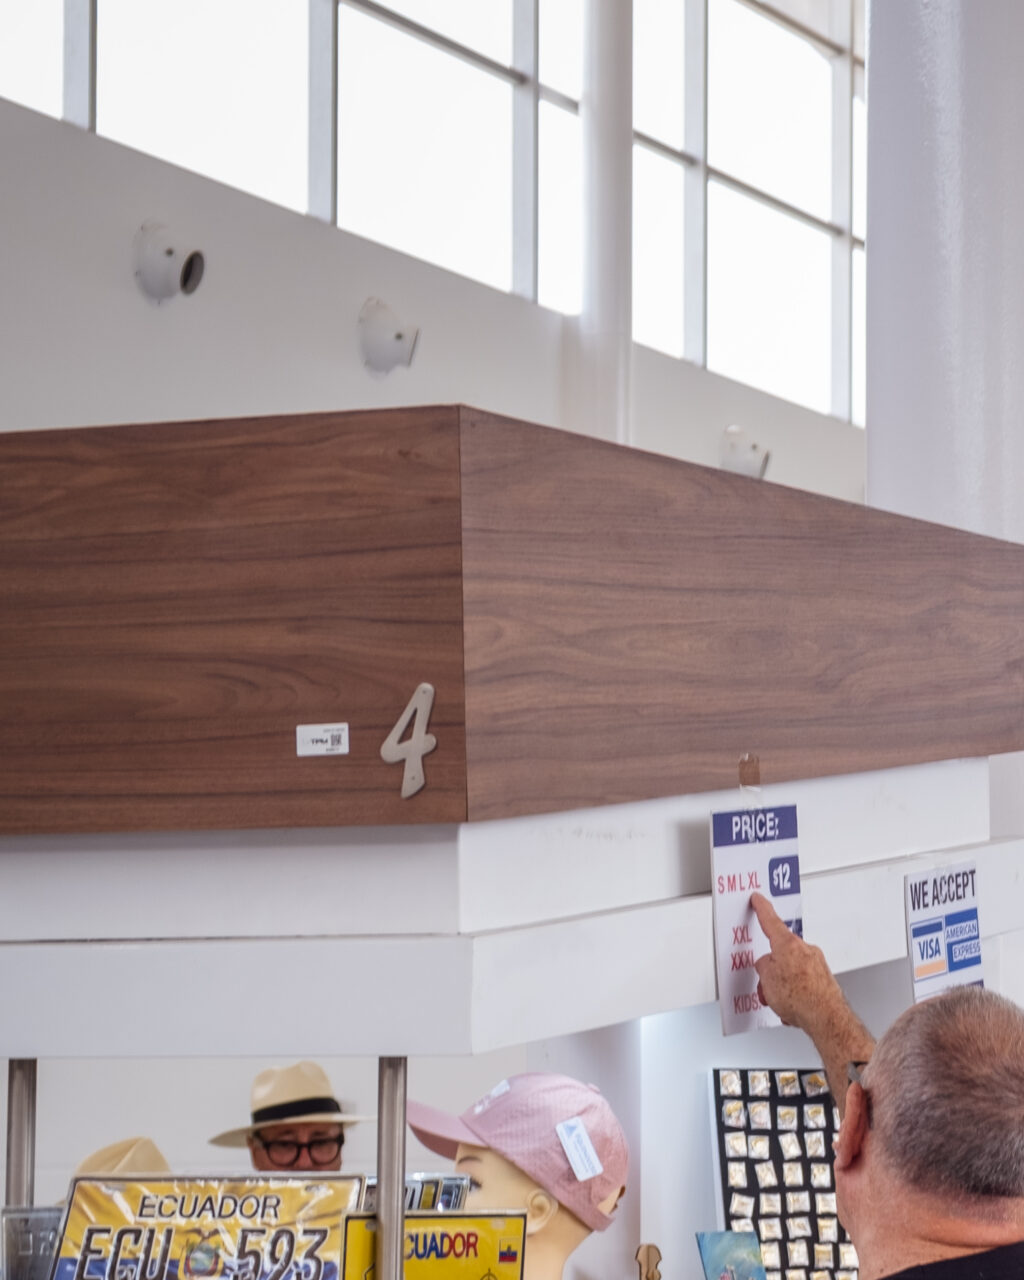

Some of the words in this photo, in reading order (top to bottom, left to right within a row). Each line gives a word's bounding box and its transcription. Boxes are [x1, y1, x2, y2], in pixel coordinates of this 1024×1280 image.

[380, 682, 437, 799] 4
[718, 874, 725, 894] S
[727, 873, 737, 893] M
[739, 872, 746, 891] L
[748, 871, 762, 889] XL
[772, 862, 792, 891] $12
[910, 880, 929, 911] WE
[932, 868, 976, 907] ACCEPT
[732, 924, 753, 944] XXL
[946, 921, 977, 940] AMERICAN
[918, 937, 941, 961] VISA
[953, 941, 981, 959] EXPRESS
[138, 1194, 281, 1220] ECUADOR
